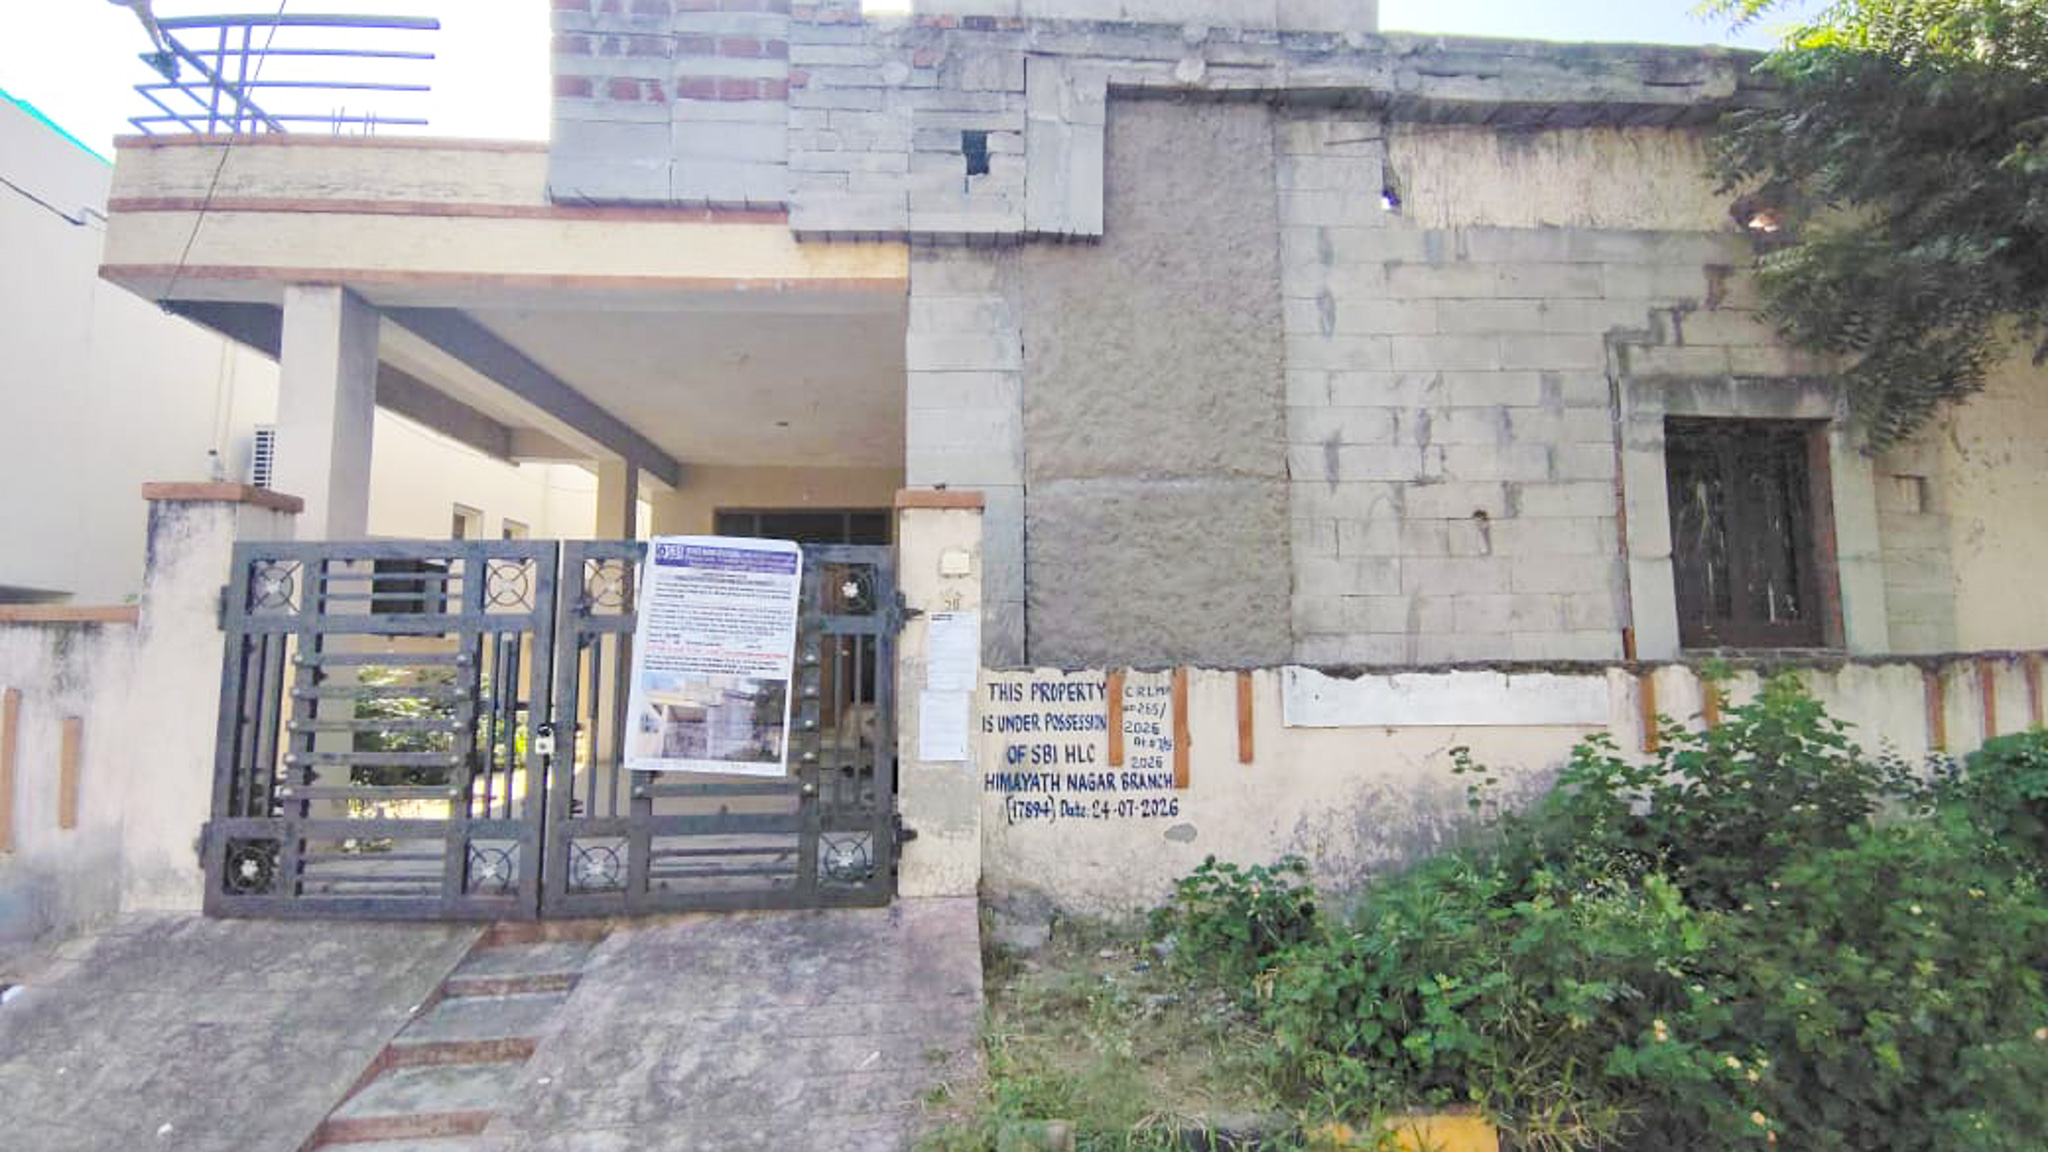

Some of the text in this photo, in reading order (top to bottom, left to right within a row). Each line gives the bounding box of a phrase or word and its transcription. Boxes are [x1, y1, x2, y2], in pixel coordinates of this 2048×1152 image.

[987, 682, 1106, 702] THIS PROPERTY
[982, 712, 1107, 733] IS UNDER POSSESSION
[1006, 745, 1095, 764] OF SBI HLC
[984, 772, 1172, 793] HIMAYATH NAGAR BRANCH
[1092, 798, 1179, 820] 24-07-2026
